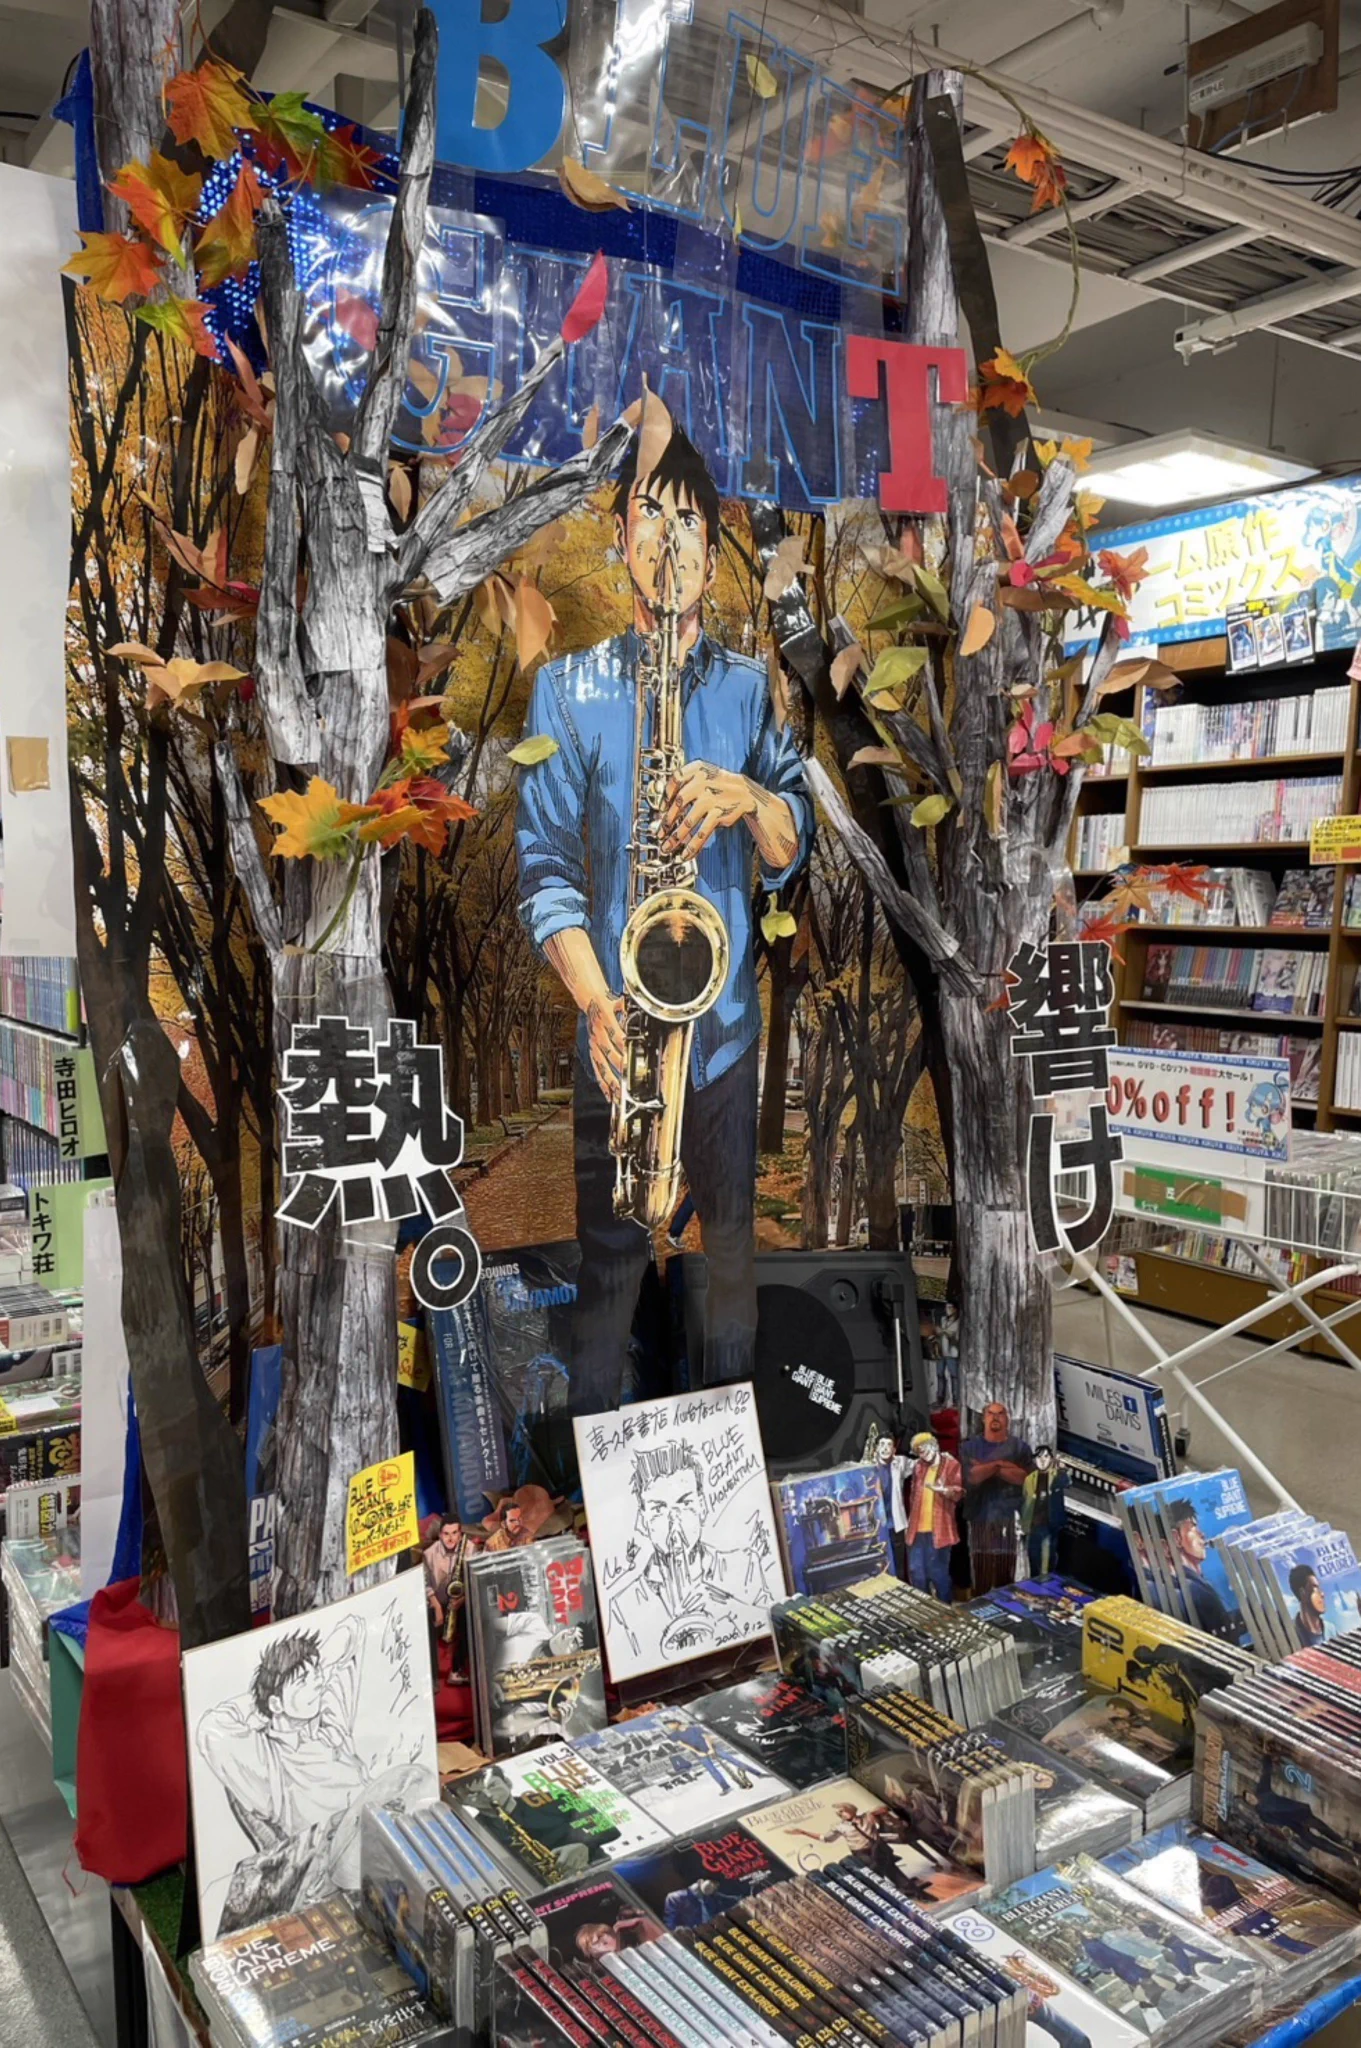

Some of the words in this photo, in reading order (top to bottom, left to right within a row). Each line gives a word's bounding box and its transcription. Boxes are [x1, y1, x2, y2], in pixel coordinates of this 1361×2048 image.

[1149, 508, 1284, 580] ーム原作
[1155, 545, 1307, 630] コミックス
[54, 1057, 79, 1157] 寺田ヒロオ
[1008, 940, 1124, 1254] 響け
[1106, 1075, 1236, 1133] 0%off!
[32, 1192, 54, 1275] トキワ荘
[443, 1332, 454, 1349] FOR
[1085, 1381, 1123, 1408] MILES
[1105, 1404, 1142, 1432] DAVIS
[701, 1423, 744, 1464] BLUE
[708, 1444, 746, 1488] GIANT
[708, 1454, 761, 1514] MOMENTUM
[1220, 1476, 1239, 1492] BLUE
[1220, 1488, 1242, 1505] GIANT
[1214, 1501, 1248, 1520] SUPREME
[1316, 1539, 1349, 1558] BLUE
[497, 1591, 520, 1613] 2
[545, 1560, 569, 1626] GIANT
[564, 1555, 585, 1613] BLUE
[522, 1757, 590, 1793] BLUE
[535, 1747, 575, 1768] VOL.3
[1284, 1764, 1312, 1793] 2
[692, 1830, 747, 1860] BLUE
[701, 1838, 763, 1874] GIANT
[548, 1881, 614, 1908] SUPREME
[826, 1880, 849, 1898] BLUE
[847, 1896, 873, 1916] GIANT
[870, 1912, 914, 1949] EXPLORER
[843, 1874, 865, 1892] BLUE
[864, 1888, 890, 1910] GIANT
[888, 1906, 931, 1942] EXPLORER
[860, 1866, 882, 1885] BLUE
[879, 1882, 905, 1902] GIANT
[902, 1900, 945, 1932] EXPLORER
[953, 1915, 996, 1942] 8
[217, 1936, 337, 1996] SUPREME
[694, 1940, 718, 1961] BLUE
[713, 1957, 741, 1981] GIANT
[736, 1978, 781, 2018] EXPLORER
[713, 1934, 738, 1955] BLUE
[732, 1951, 761, 1975] GIANT
[755, 1972, 800, 2011] EXPLORER
[728, 1926, 753, 1948] BLUE
[747, 1944, 775, 1967] GIANT
[771, 1963, 816, 2001] EXPLORER
[747, 1918, 771, 1937] BLUE
[767, 1935, 794, 1956] GIANT
[790, 1954, 834, 1991] EXPLORER
